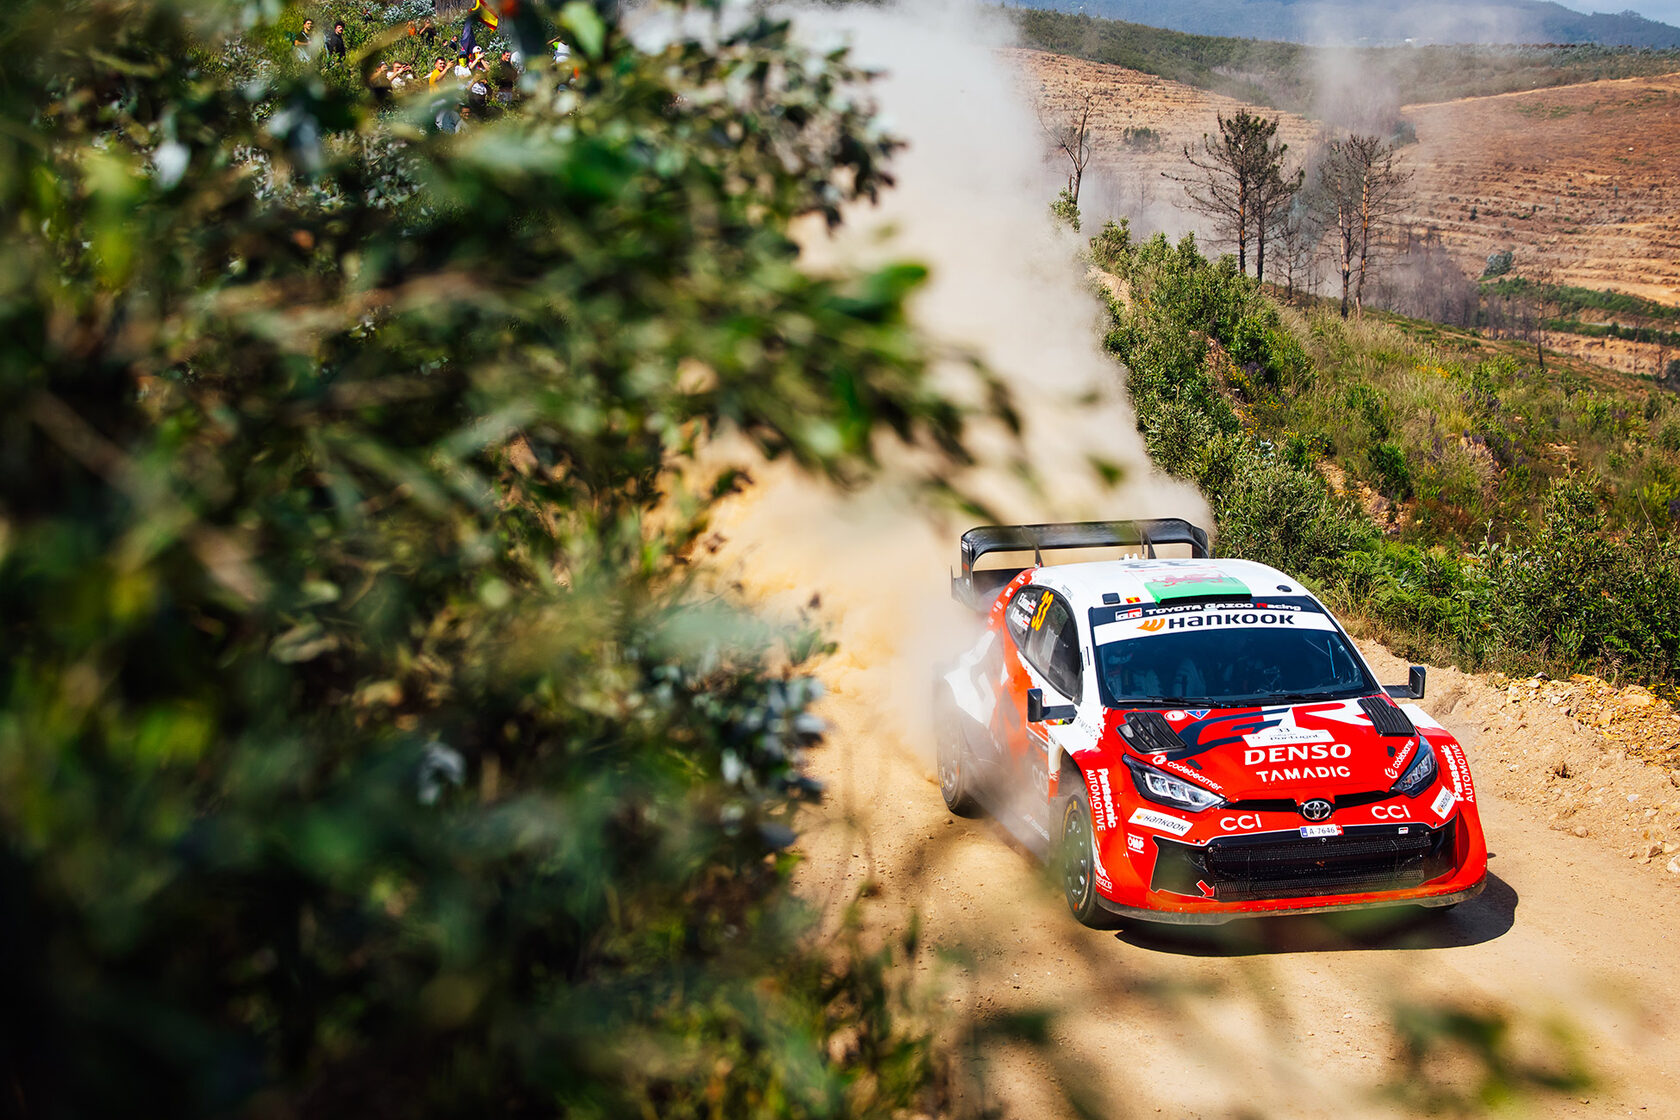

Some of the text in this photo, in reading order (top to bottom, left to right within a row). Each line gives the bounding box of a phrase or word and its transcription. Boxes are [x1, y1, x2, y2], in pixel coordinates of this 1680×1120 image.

[1030, 590, 1054, 631] 33
[1145, 604, 1201, 616] TOYOTA
[1205, 602, 1254, 610] GAZOO
[1256, 602, 1302, 611] Racing
[1244, 743, 1352, 766] DENSO
[1167, 760, 1223, 791] codebeamer
[1255, 765, 1351, 783] TAMADIC
[1441, 744, 1465, 802] Panasonic
[1450, 743, 1475, 803] AUTOMOTIVE
[1085, 769, 1106, 832] AUTOMOTIVE
[1097, 767, 1119, 829] Panasonic
[1219, 813, 1263, 832] CCI
[1371, 804, 1411, 820] CCI
[1309, 825, 1336, 836] A-7646
